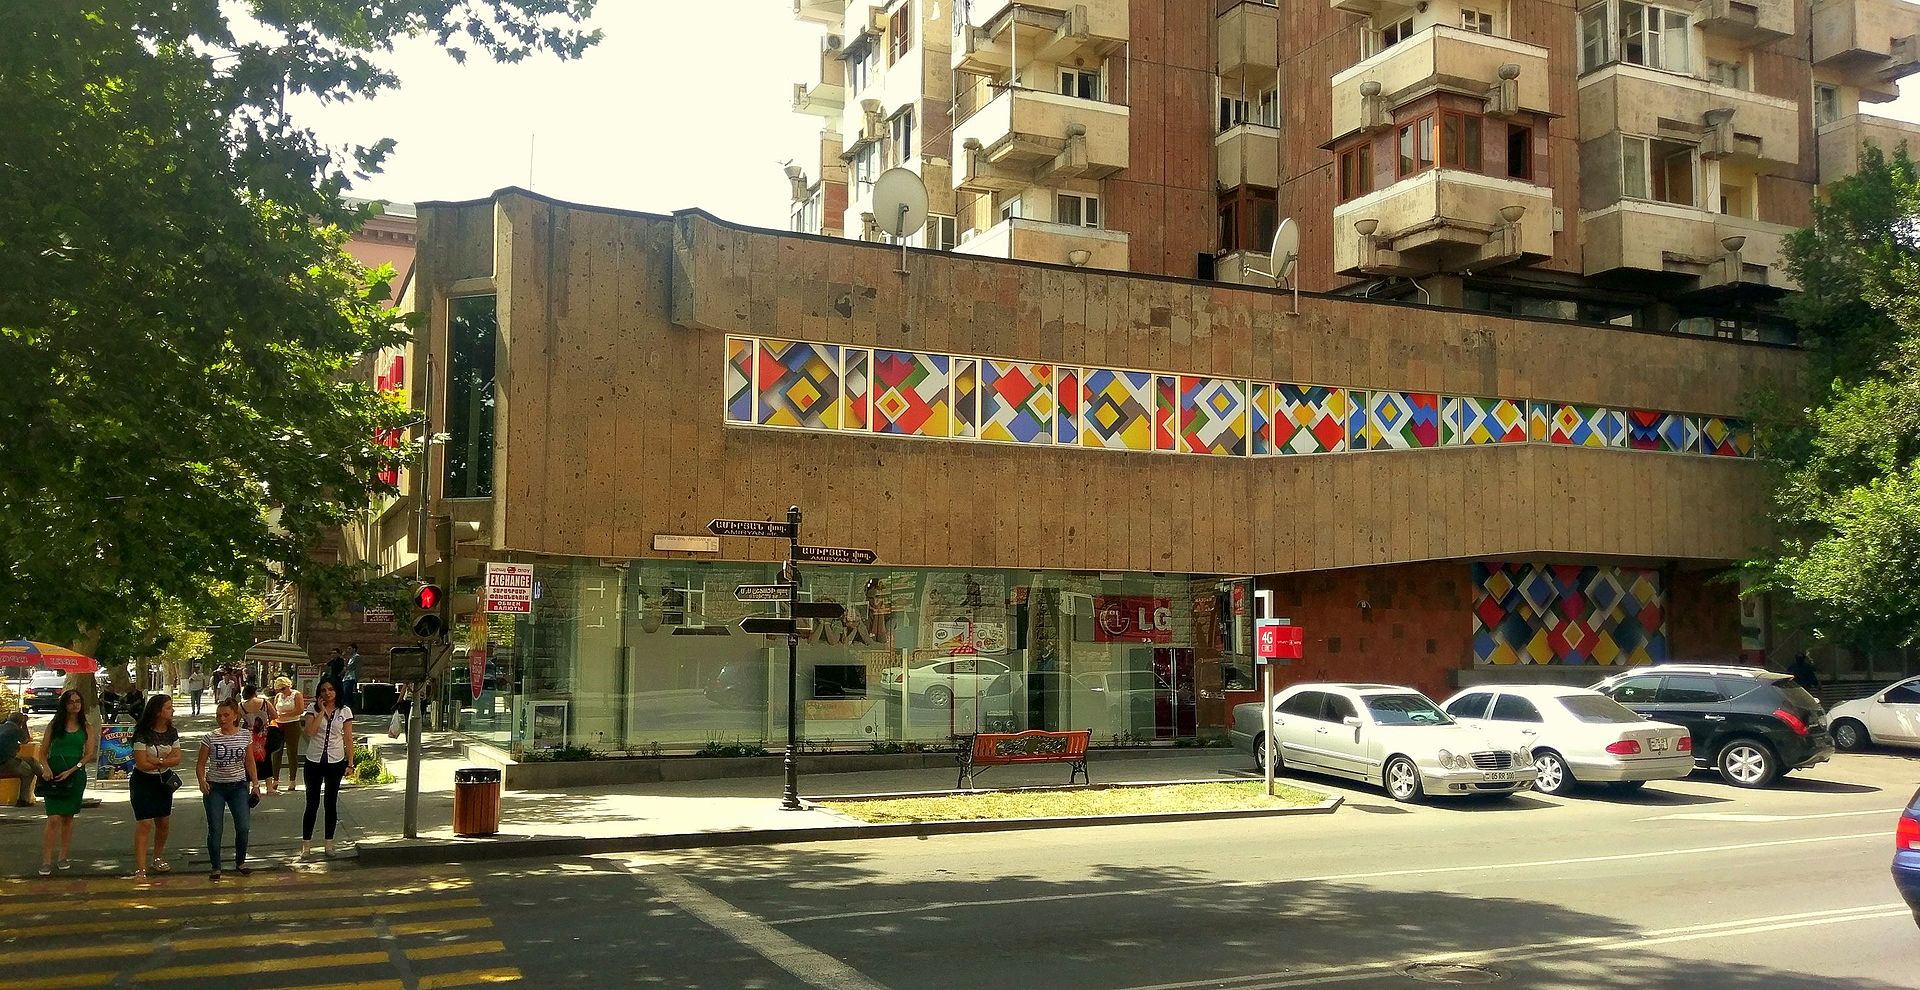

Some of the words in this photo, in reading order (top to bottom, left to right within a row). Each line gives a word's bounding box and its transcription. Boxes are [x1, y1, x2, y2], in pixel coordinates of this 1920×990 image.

[715, 521, 764, 531] ԱՄԻՐՅԱՆ
[802, 547, 849, 557] ԱՄԻՐՅԱՆ
[490, 574, 530, 586] EXCHANGE
[1138, 607, 1172, 631] LG
[1261, 631, 1273, 644] 4G
